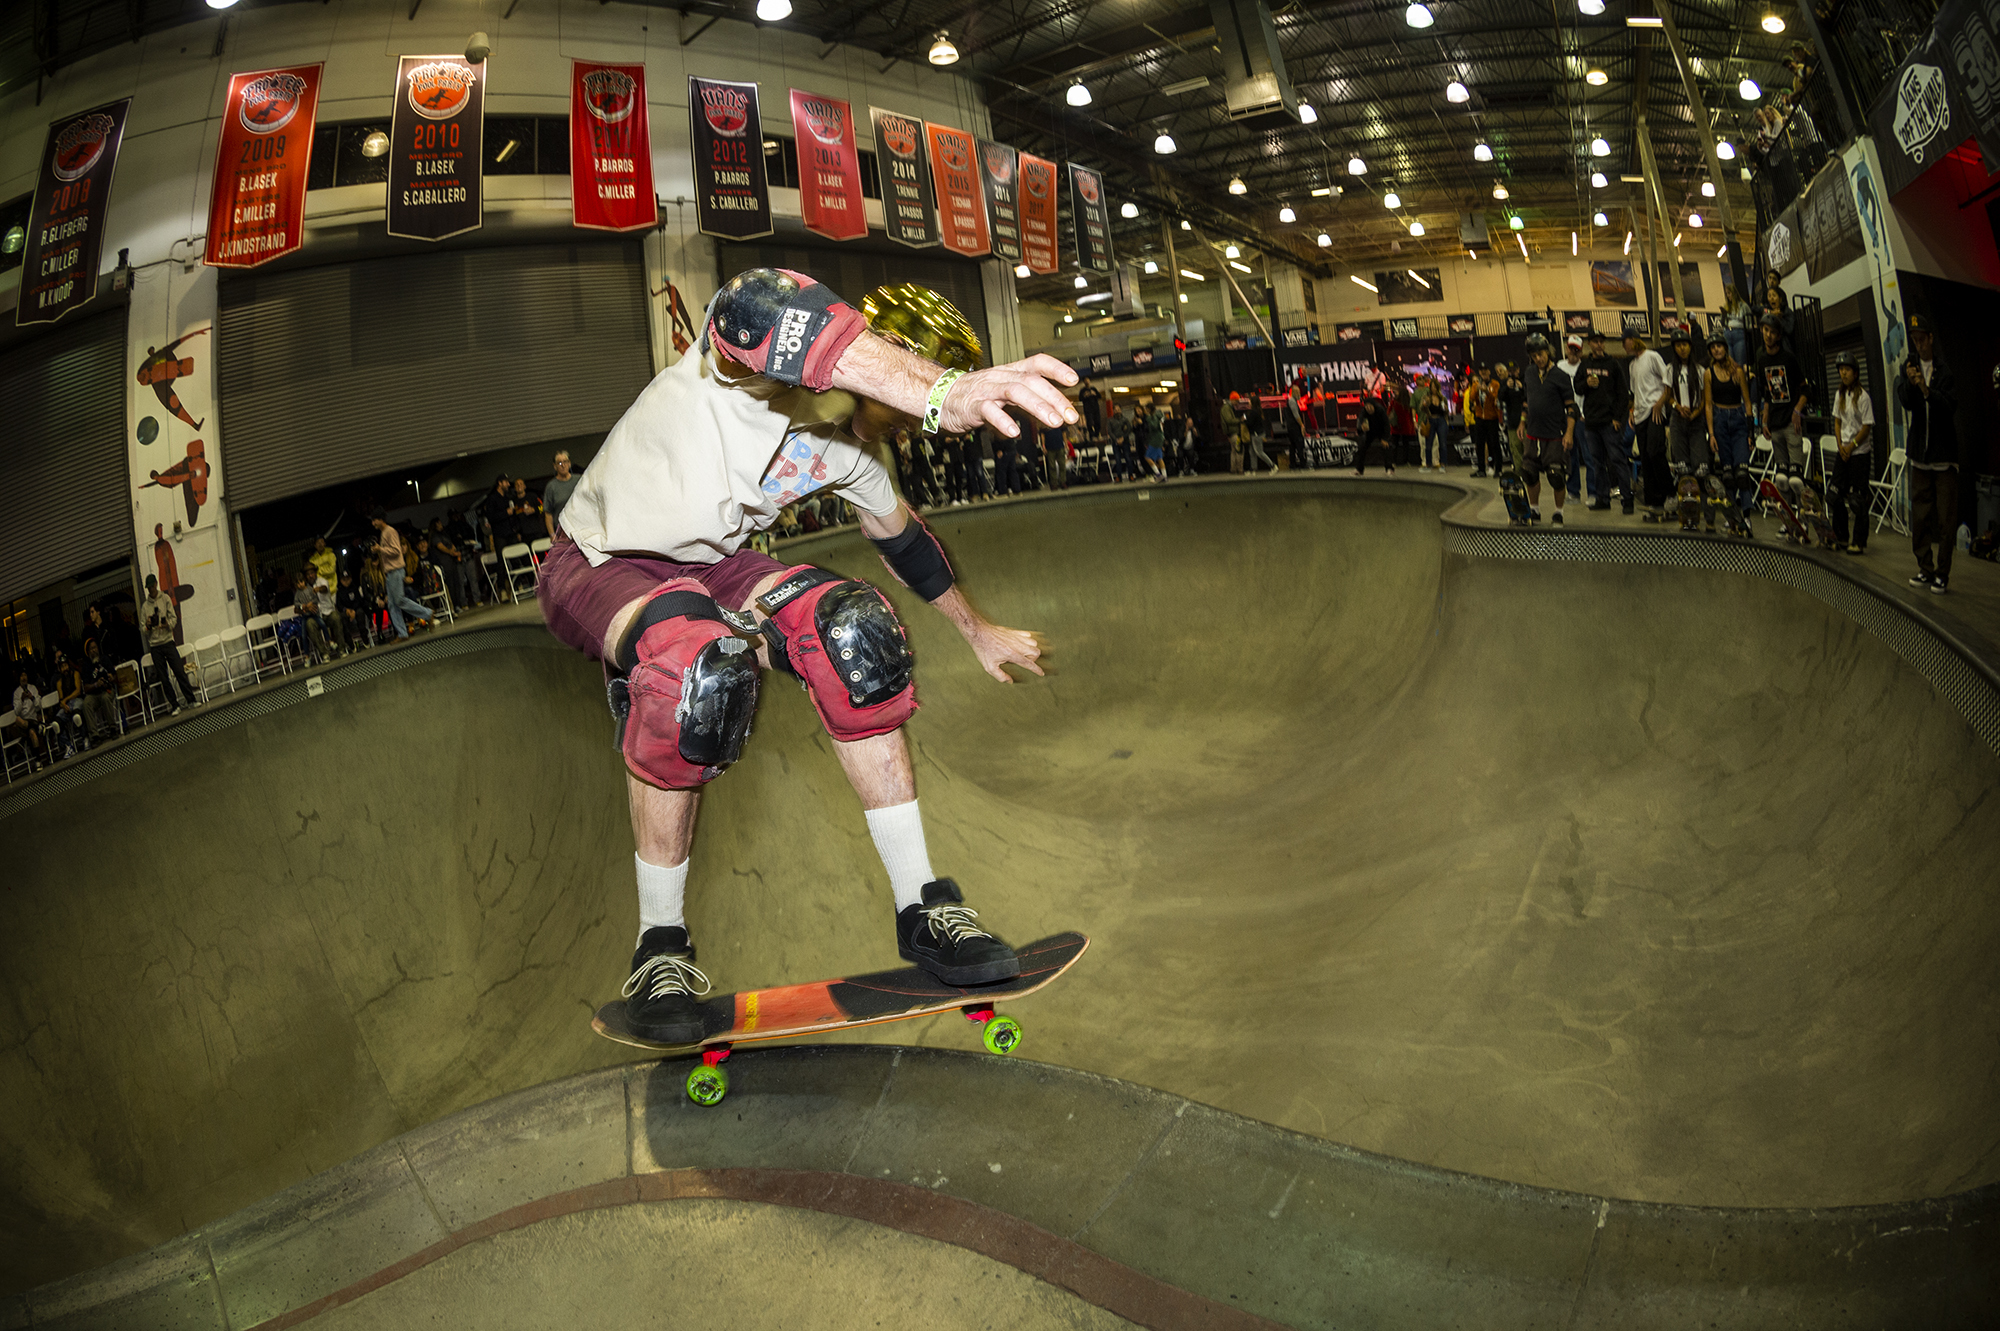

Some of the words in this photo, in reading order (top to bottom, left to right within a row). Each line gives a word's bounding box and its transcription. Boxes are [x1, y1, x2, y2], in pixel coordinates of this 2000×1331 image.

[1900, 67, 1922, 111] VANS
[1910, 98, 1932, 138] THE
[414, 123, 460, 149] 2010
[594, 125, 631, 149] 2011
[240, 135, 286, 164] 2009
[442, 151, 463, 160] PRO
[713, 139, 747, 163] 2012
[815, 147, 841, 167] 2013
[234, 166, 262, 177] MENS
[266, 163, 287, 172] PRO
[416, 160, 455, 176] B.LASEK
[594, 158, 634, 173] P.BARROS
[892, 160, 916, 180] 2014
[239, 172, 278, 193] B.LASEK
[410, 179, 460, 188] MASTERS
[714, 170, 750, 186] P.BARROS
[948, 174, 969, 191] 2015
[50, 178, 91, 215] 2008
[234, 193, 281, 205] MASTERS
[403, 186, 466, 206] S.CABALLERO
[598, 184, 636, 199] C.MILLER
[715, 188, 752, 196] MASTERS
[719, 195, 758, 211] CABALLERO
[820, 194, 847, 210] C.MILLER
[72, 208, 88, 219] PRO
[233, 204, 276, 224] C.MILLER
[41, 216, 88, 247] R.GLIFBERG
[220, 226, 264, 238] WOMENS
[267, 221, 288, 231] PRO
[901, 225, 926, 240] C.MILLER
[41, 240, 81, 259] MASTERS
[218, 232, 286, 259] J.KINDSTRAND
[41, 248, 79, 276] C.MILLER
[39, 280, 74, 309] M.KNOOP
[1391, 319, 1417, 333] VANS
[1284, 329, 1308, 344] VANS
